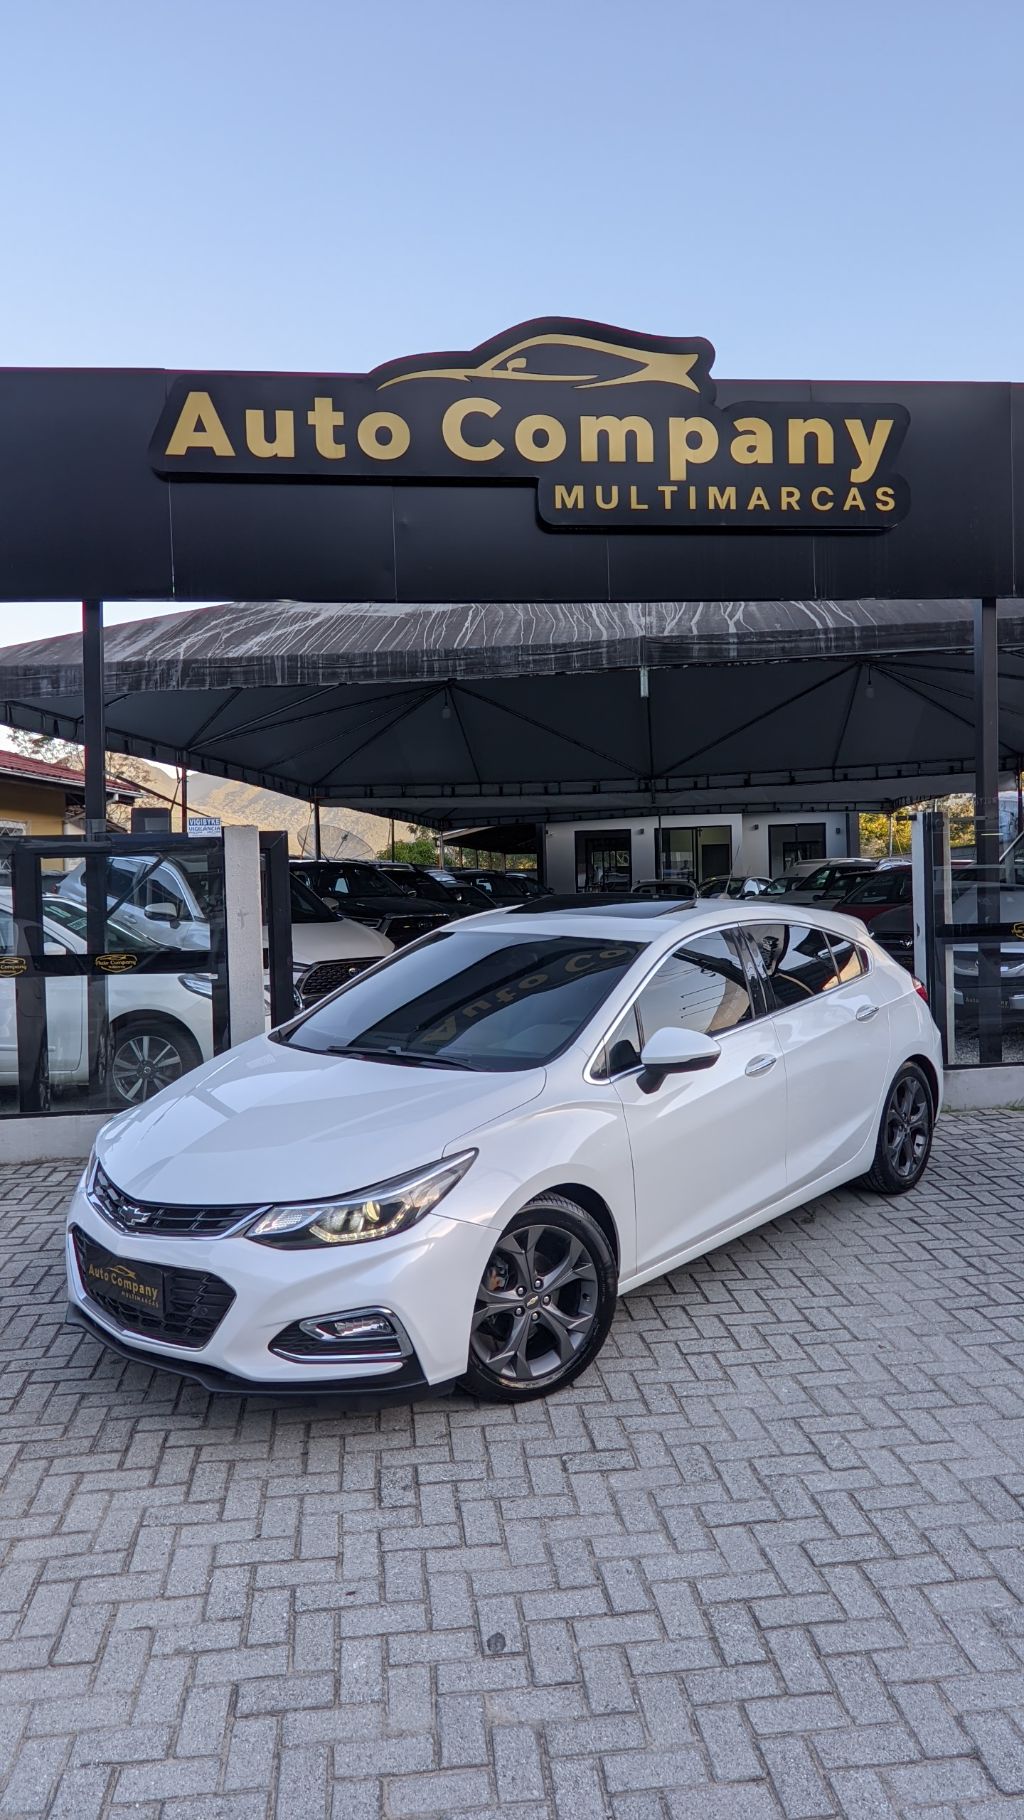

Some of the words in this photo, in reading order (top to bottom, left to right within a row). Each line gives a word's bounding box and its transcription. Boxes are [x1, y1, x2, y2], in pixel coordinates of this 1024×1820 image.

[165, 391, 411, 461] Auto
[442, 397, 894, 483] Company
[555, 485, 896, 512] MULTIMARCAS
[88, 1263, 109, 1281] Auto
[110, 1272, 158, 1301] Company
